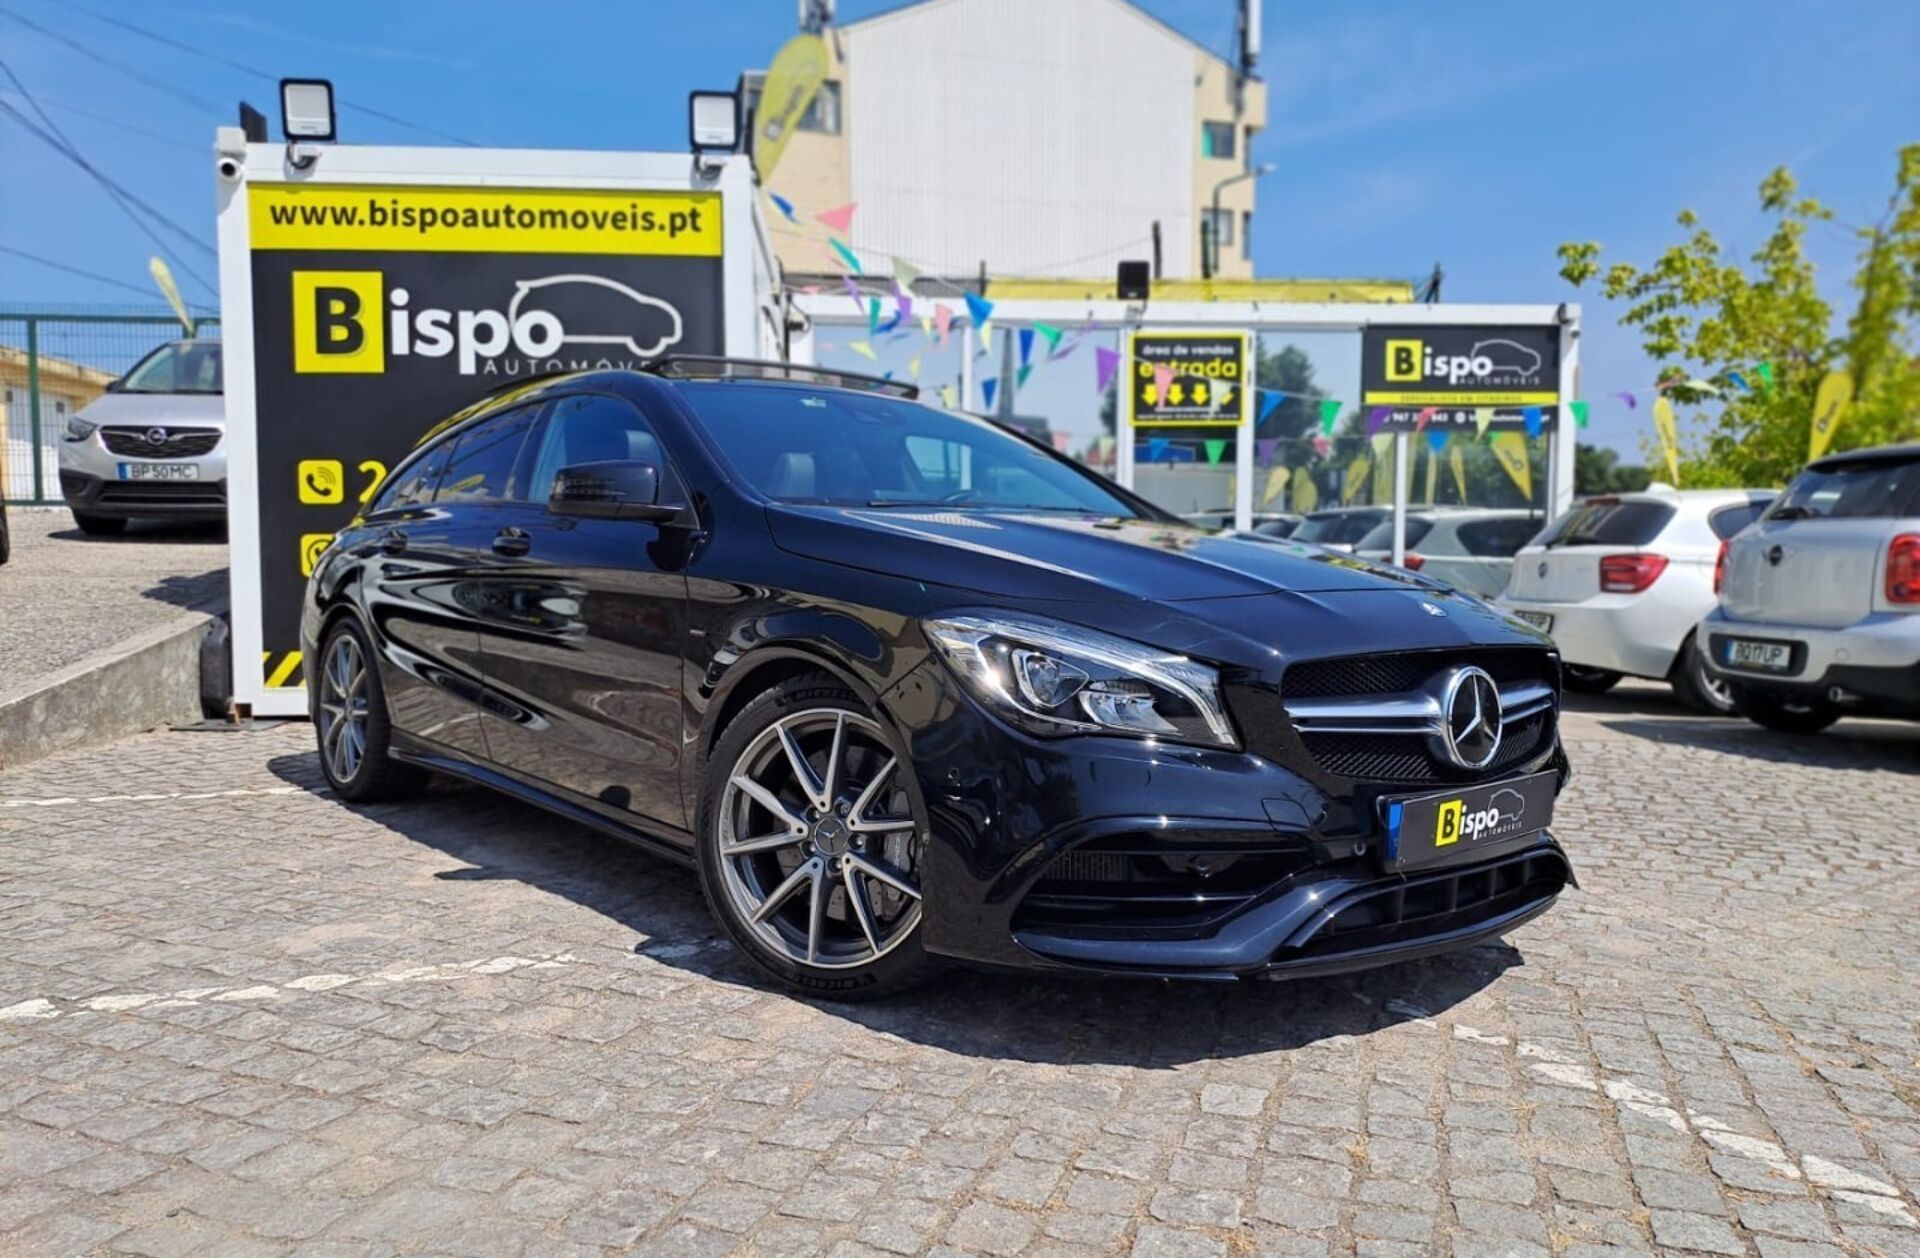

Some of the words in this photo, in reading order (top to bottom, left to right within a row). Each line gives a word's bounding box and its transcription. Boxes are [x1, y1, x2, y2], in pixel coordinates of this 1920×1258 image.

[269, 199, 703, 236] www.bispoautomoveis.pt
[313, 285, 565, 376] Bispo
[1139, 358, 1237, 378] etrada
[1394, 346, 1494, 385] Bispo
[1443, 805, 1499, 840] Bispo
